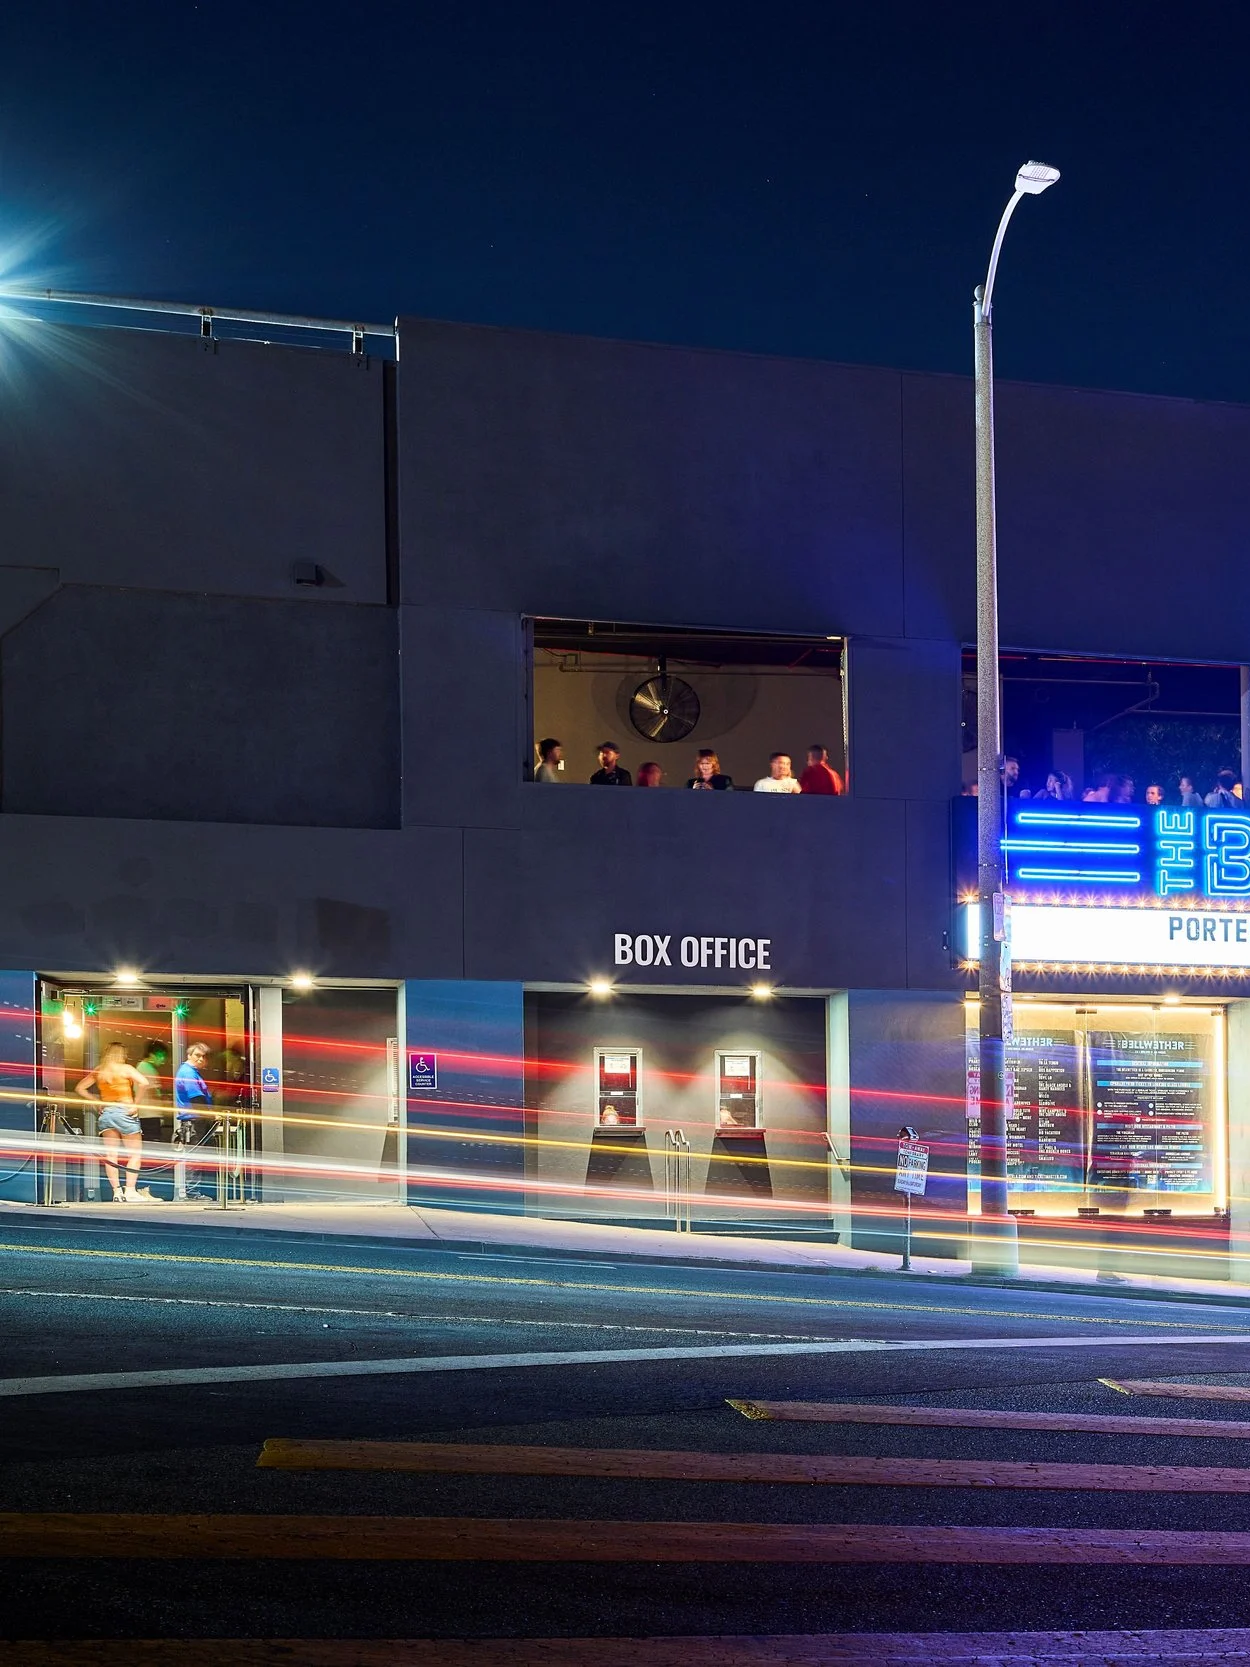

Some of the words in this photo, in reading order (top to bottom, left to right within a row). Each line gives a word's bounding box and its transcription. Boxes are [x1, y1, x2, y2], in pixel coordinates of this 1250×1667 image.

[1159, 811, 1193, 897] THE
[614, 933, 673, 967] BOX
[680, 936, 772, 970] OFFICE
[898, 1154, 908, 1168] NO
